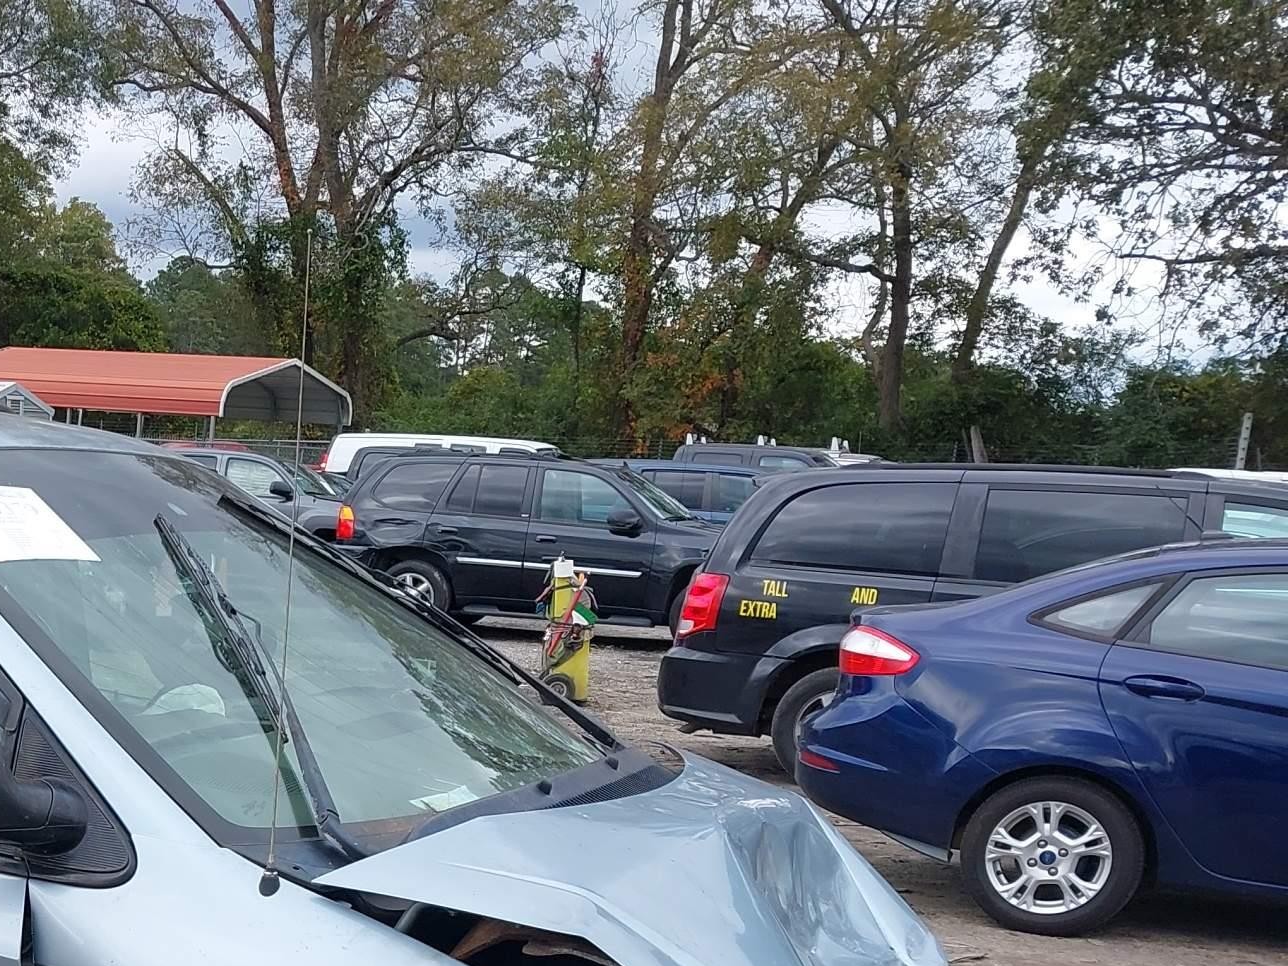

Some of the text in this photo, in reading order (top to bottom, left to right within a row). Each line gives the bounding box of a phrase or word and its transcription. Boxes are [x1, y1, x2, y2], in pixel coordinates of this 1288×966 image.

[763, 580, 878, 605] TALL AND
[739, 600, 777, 619] EXTRA
